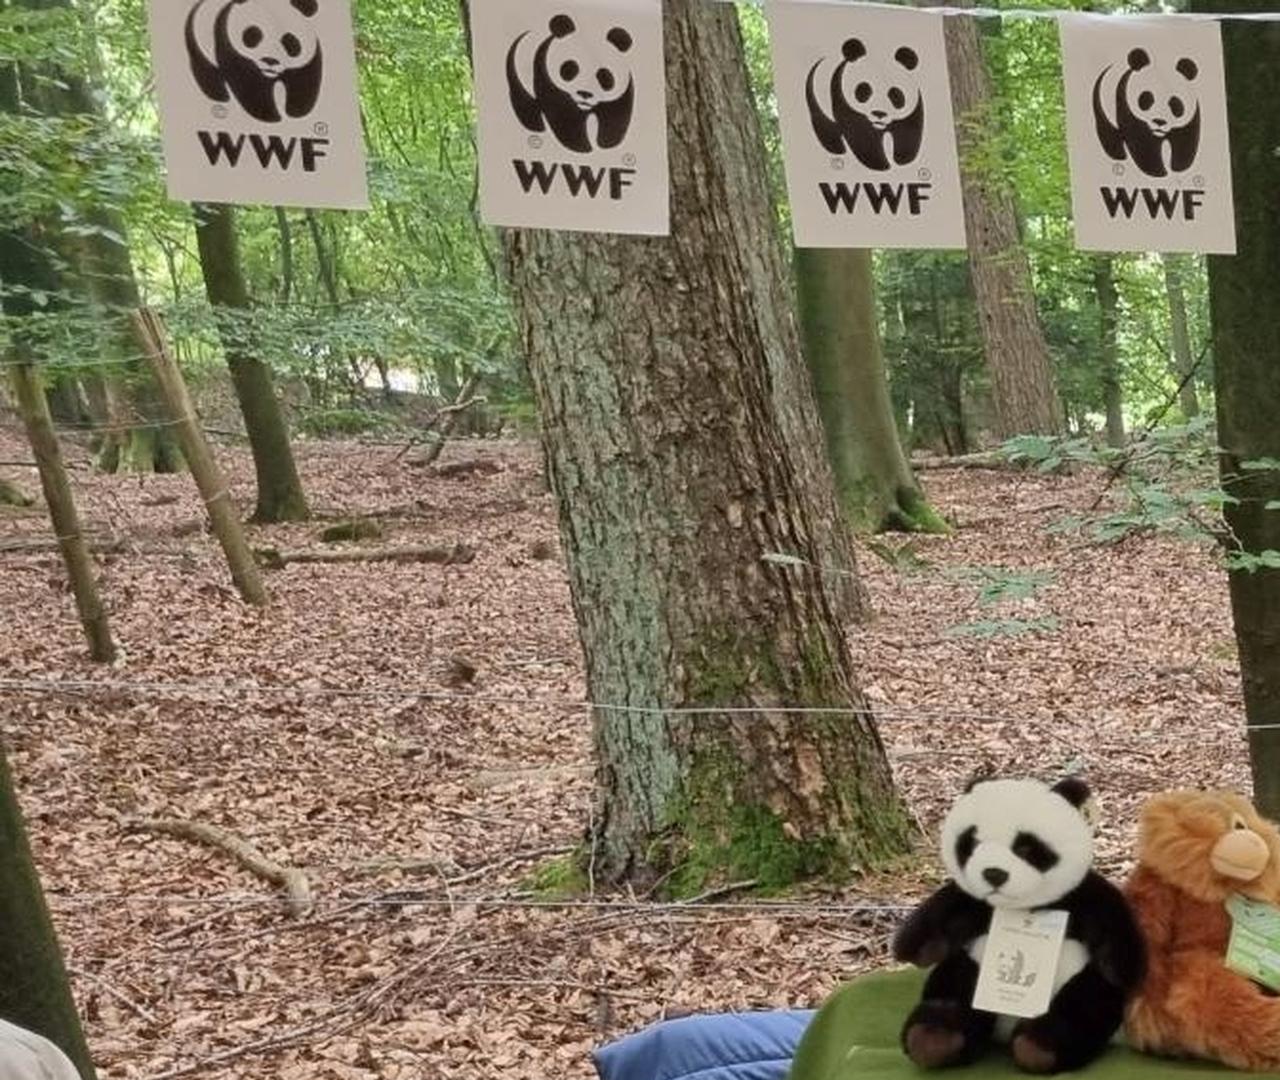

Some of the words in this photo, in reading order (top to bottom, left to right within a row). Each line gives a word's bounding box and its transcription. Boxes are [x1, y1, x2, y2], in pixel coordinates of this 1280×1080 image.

[196, 130, 330, 173] WWF
[511, 158, 637, 201] WWF
[818, 182, 932, 216] WWF
[1099, 186, 1206, 221] WWF
